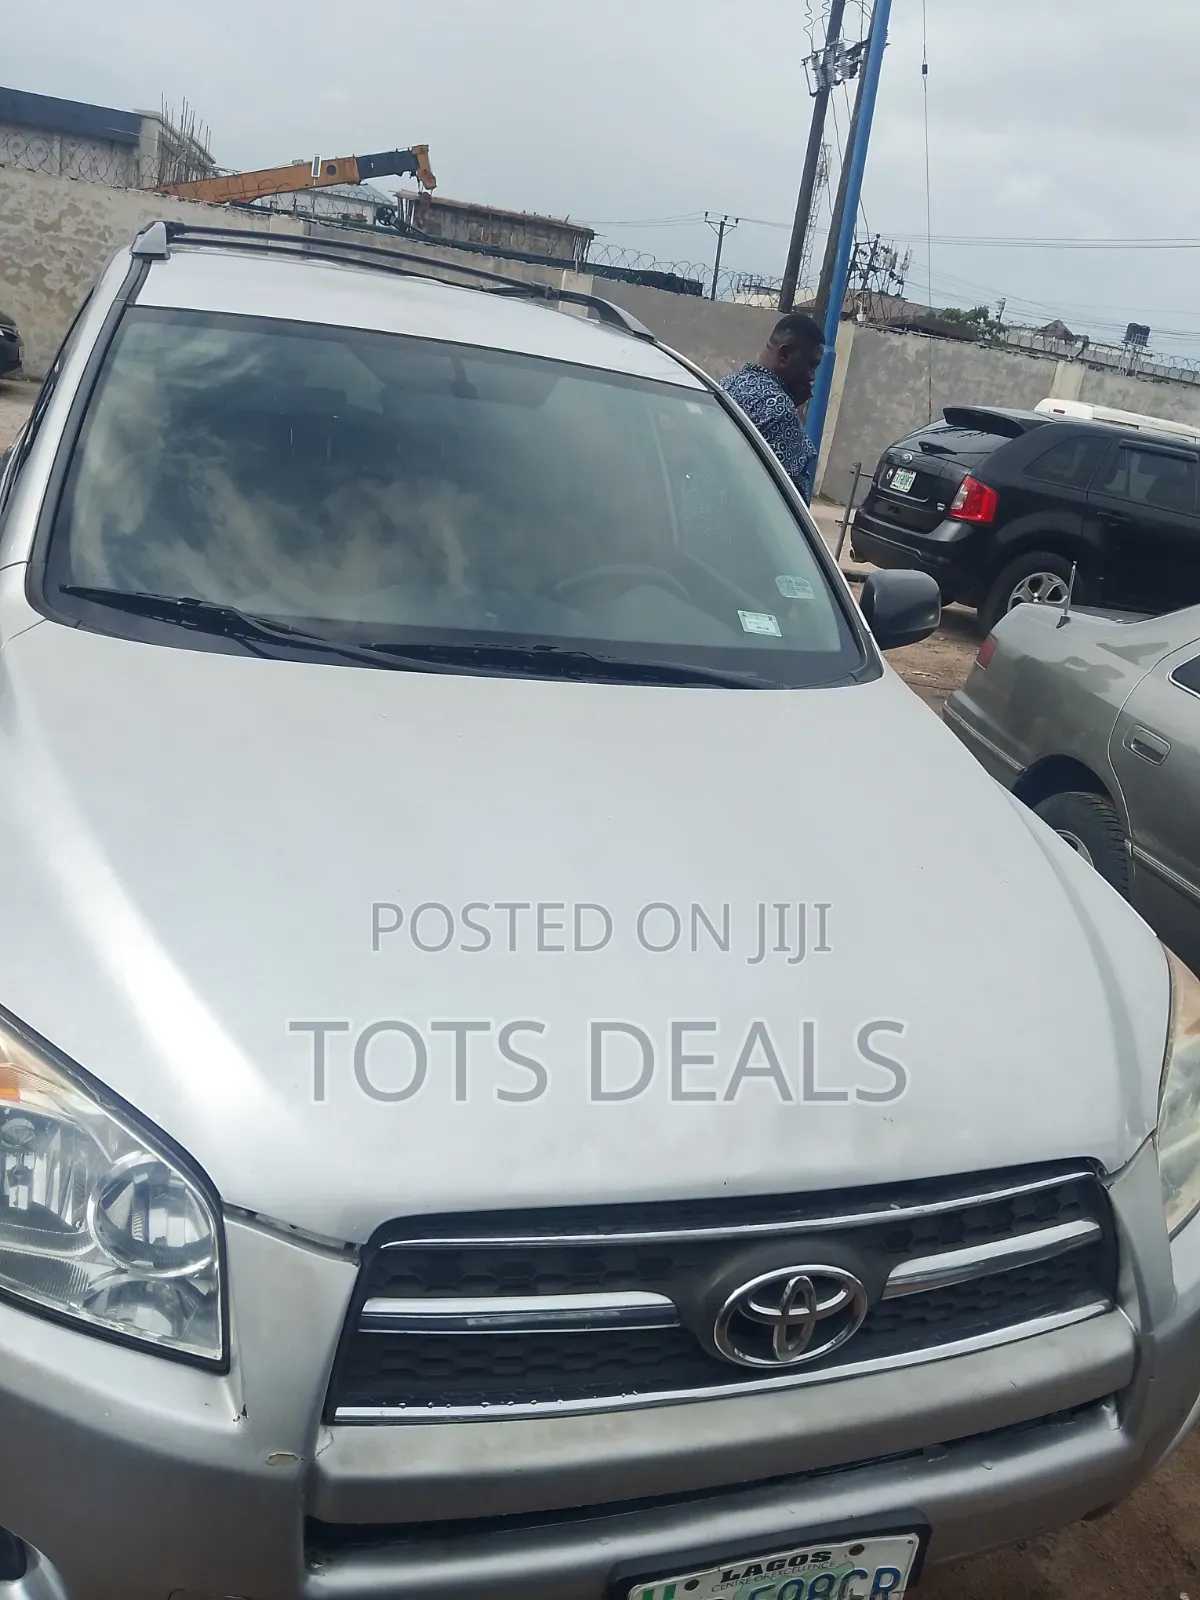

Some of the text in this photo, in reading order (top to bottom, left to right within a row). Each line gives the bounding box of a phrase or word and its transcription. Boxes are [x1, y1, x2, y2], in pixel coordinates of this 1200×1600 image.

[711, 1561, 836, 1592] CENTRE OF EXCELLENCE
[720, 1551, 832, 1583] LAGOS
